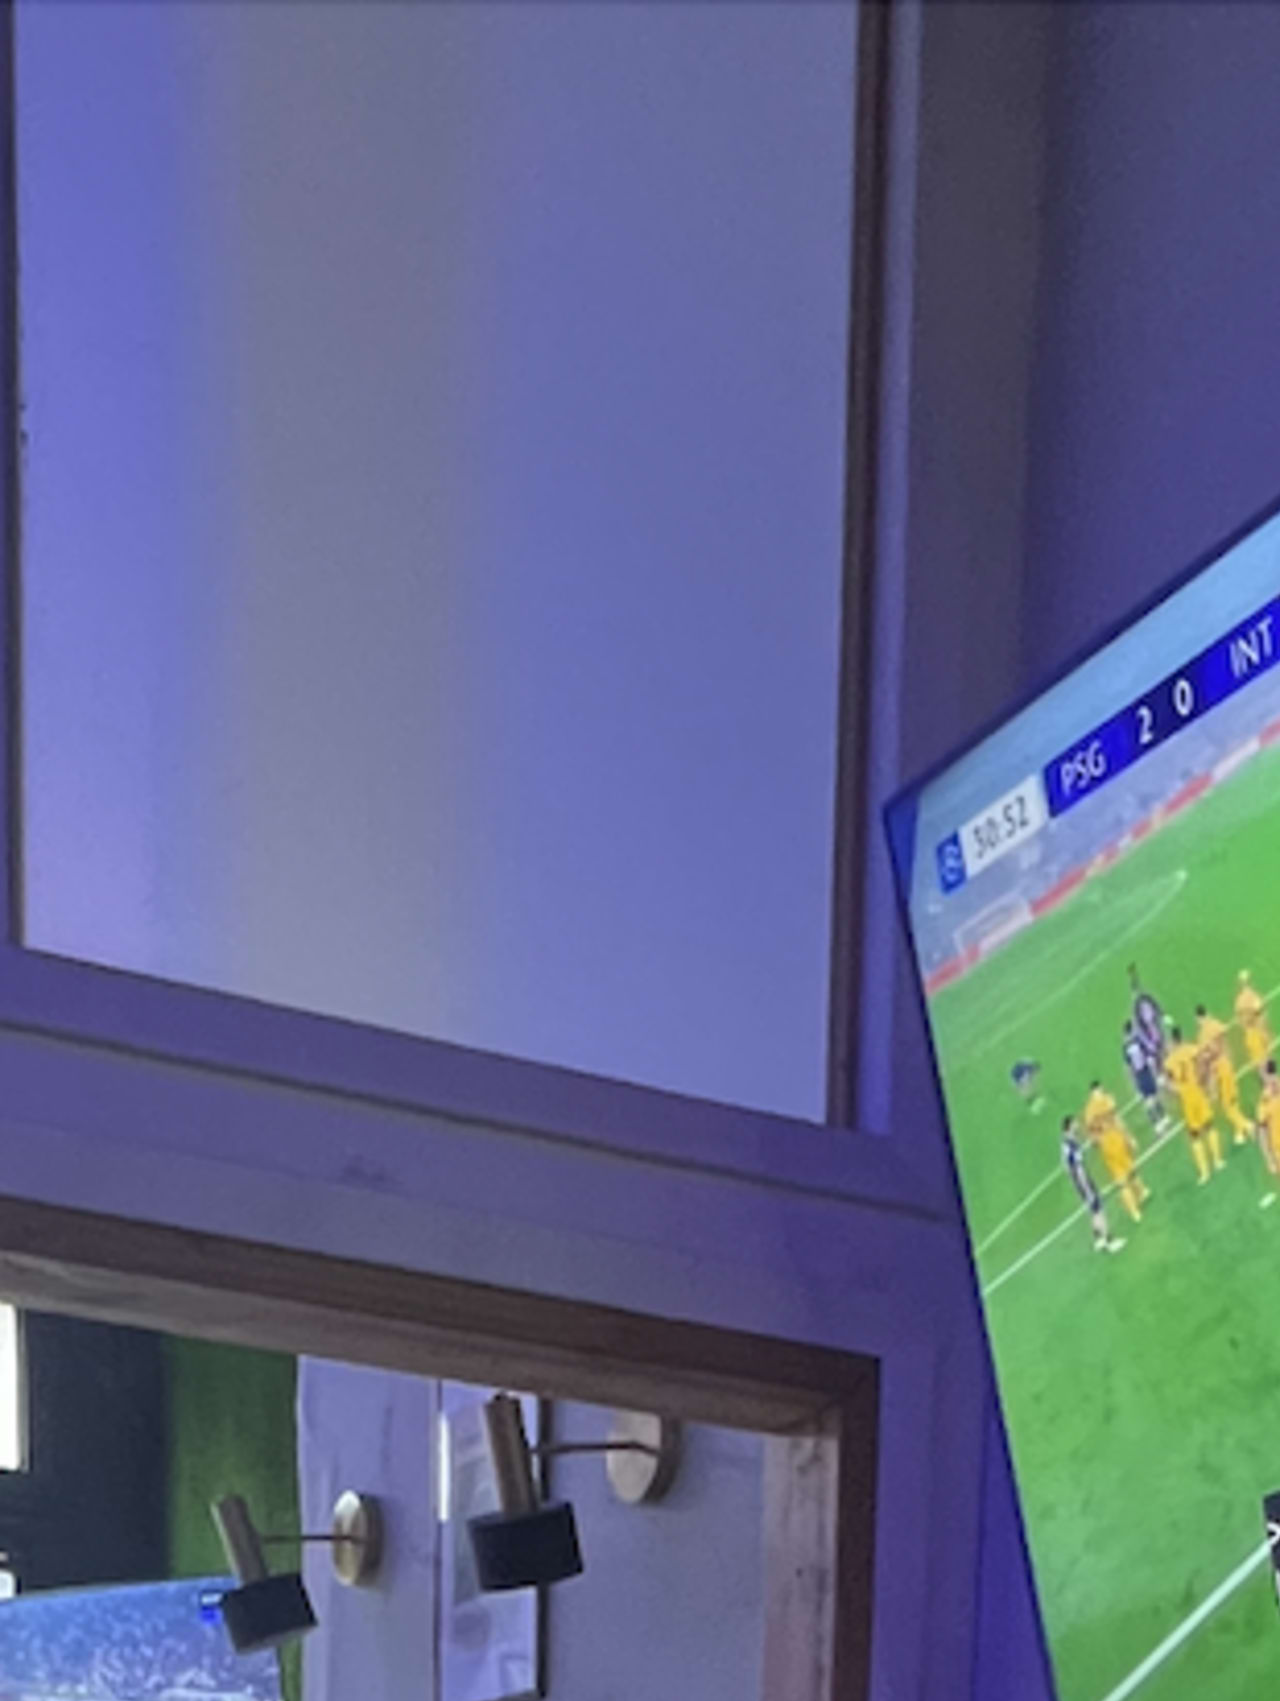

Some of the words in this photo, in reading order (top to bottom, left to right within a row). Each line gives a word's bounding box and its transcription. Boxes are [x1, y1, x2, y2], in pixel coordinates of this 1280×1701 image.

[1060, 739, 1107, 796] PSG
[1135, 704, 1154, 744] 2
[1173, 678, 1194, 717] 0
[1229, 615, 1274, 679] INT
